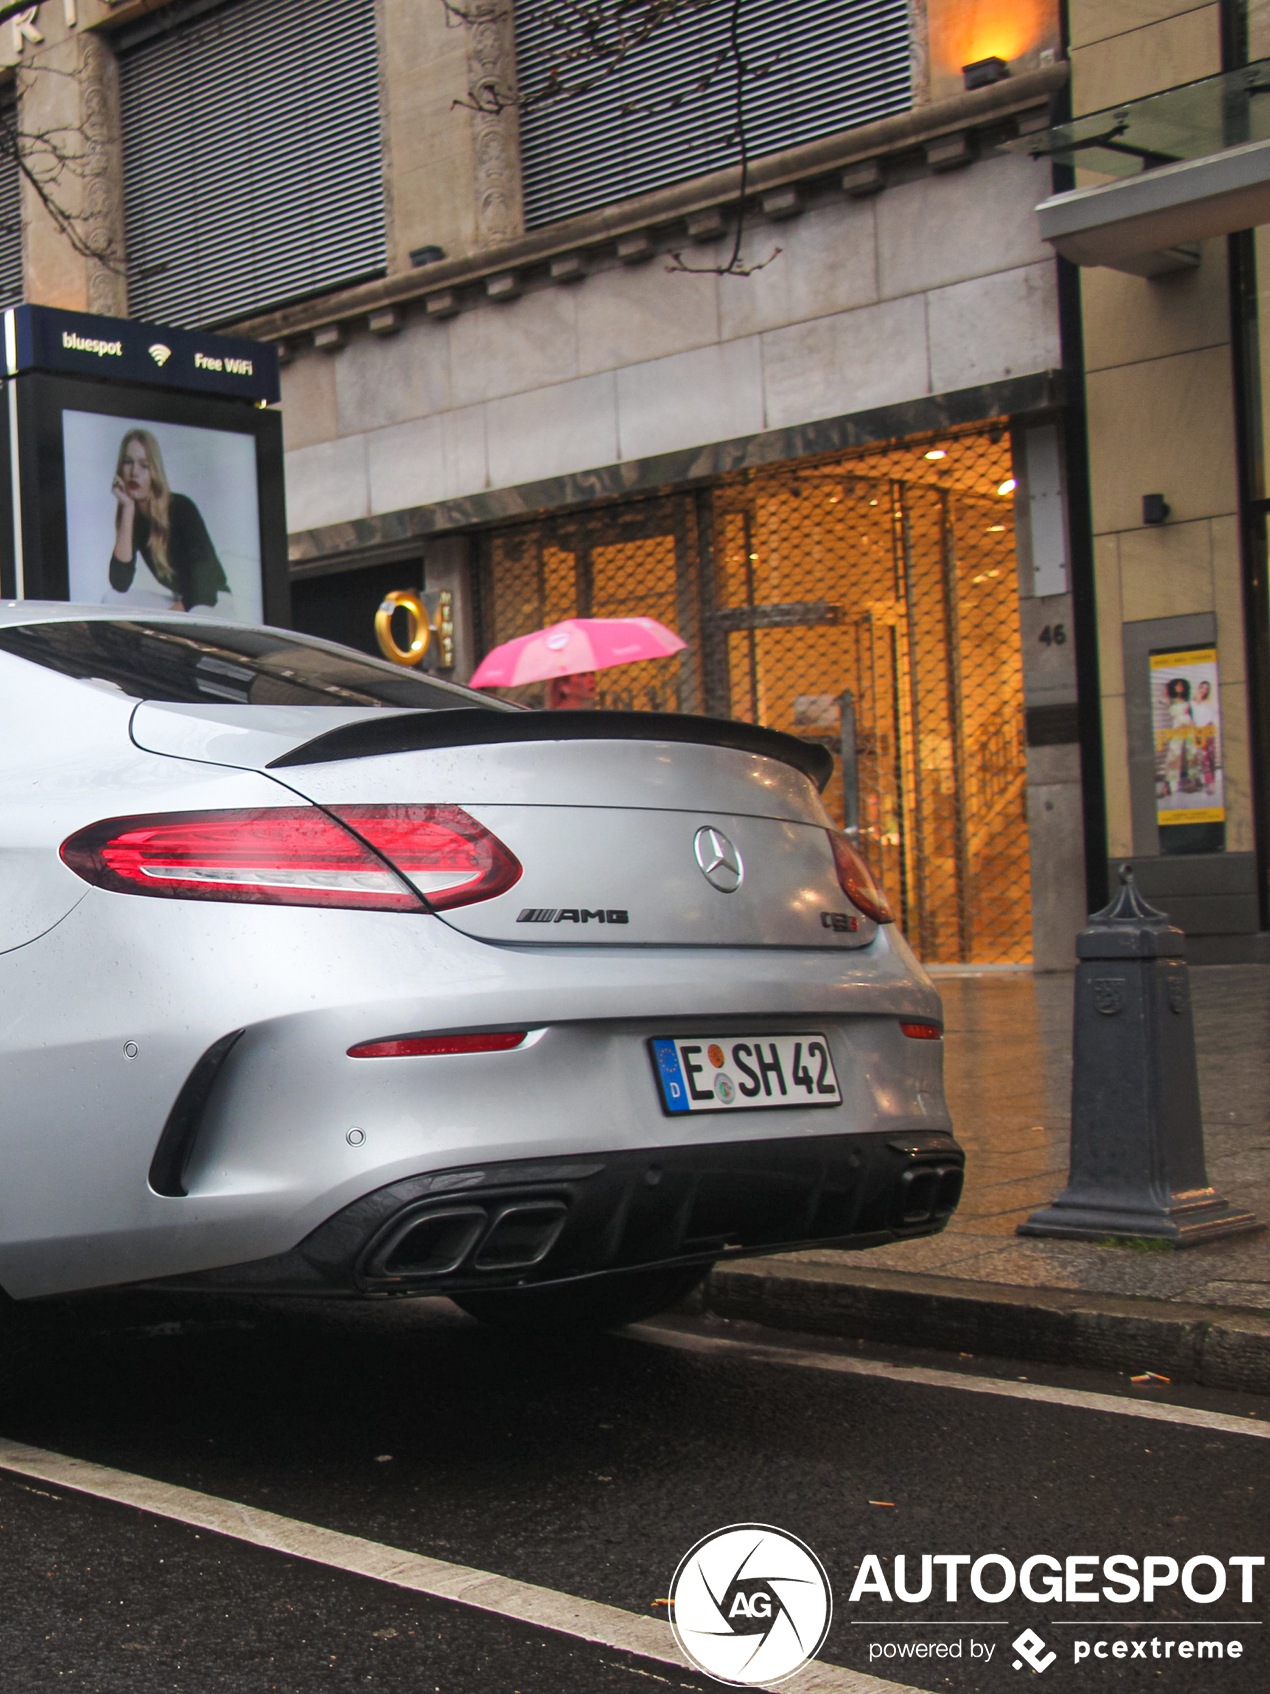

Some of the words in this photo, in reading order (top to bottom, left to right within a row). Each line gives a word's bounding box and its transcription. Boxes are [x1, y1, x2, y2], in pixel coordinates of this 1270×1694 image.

[62, 331, 123, 357] bluespot
[194, 352, 223, 371] Free
[224, 357, 254, 376] WiFi
[1038, 624, 1067, 647] 46
[553, 908, 629, 924] AMG
[680, 1045, 715, 1100] E
[669, 1082, 681, 1098] D
